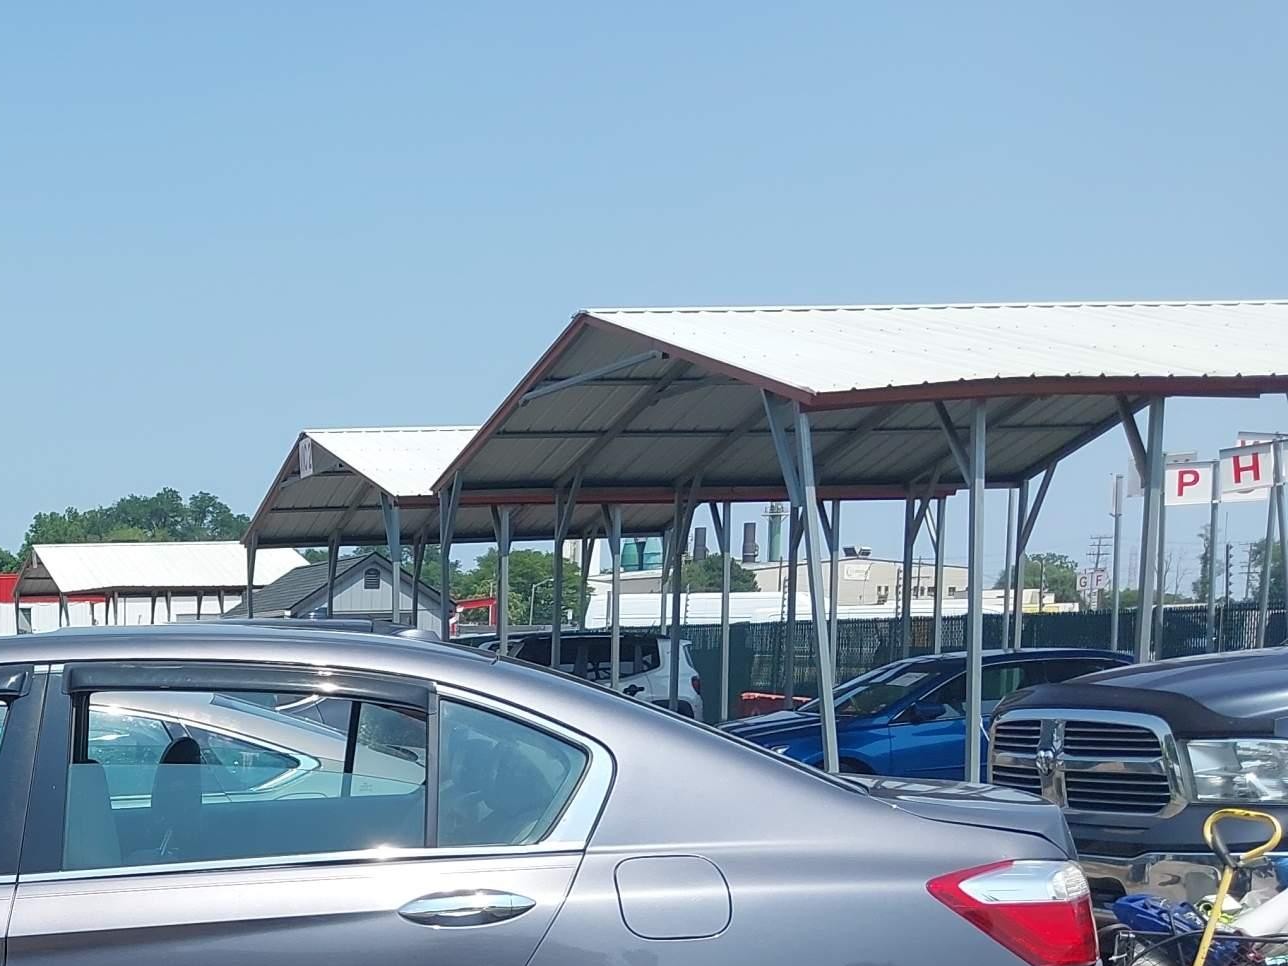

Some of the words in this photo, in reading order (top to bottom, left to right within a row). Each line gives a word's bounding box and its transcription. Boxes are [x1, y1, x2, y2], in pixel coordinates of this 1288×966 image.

[1233, 452, 1261, 484] H
[1178, 469, 1200, 497] P
[1079, 576, 1088, 588] G
[1095, 574, 1103, 587] F
